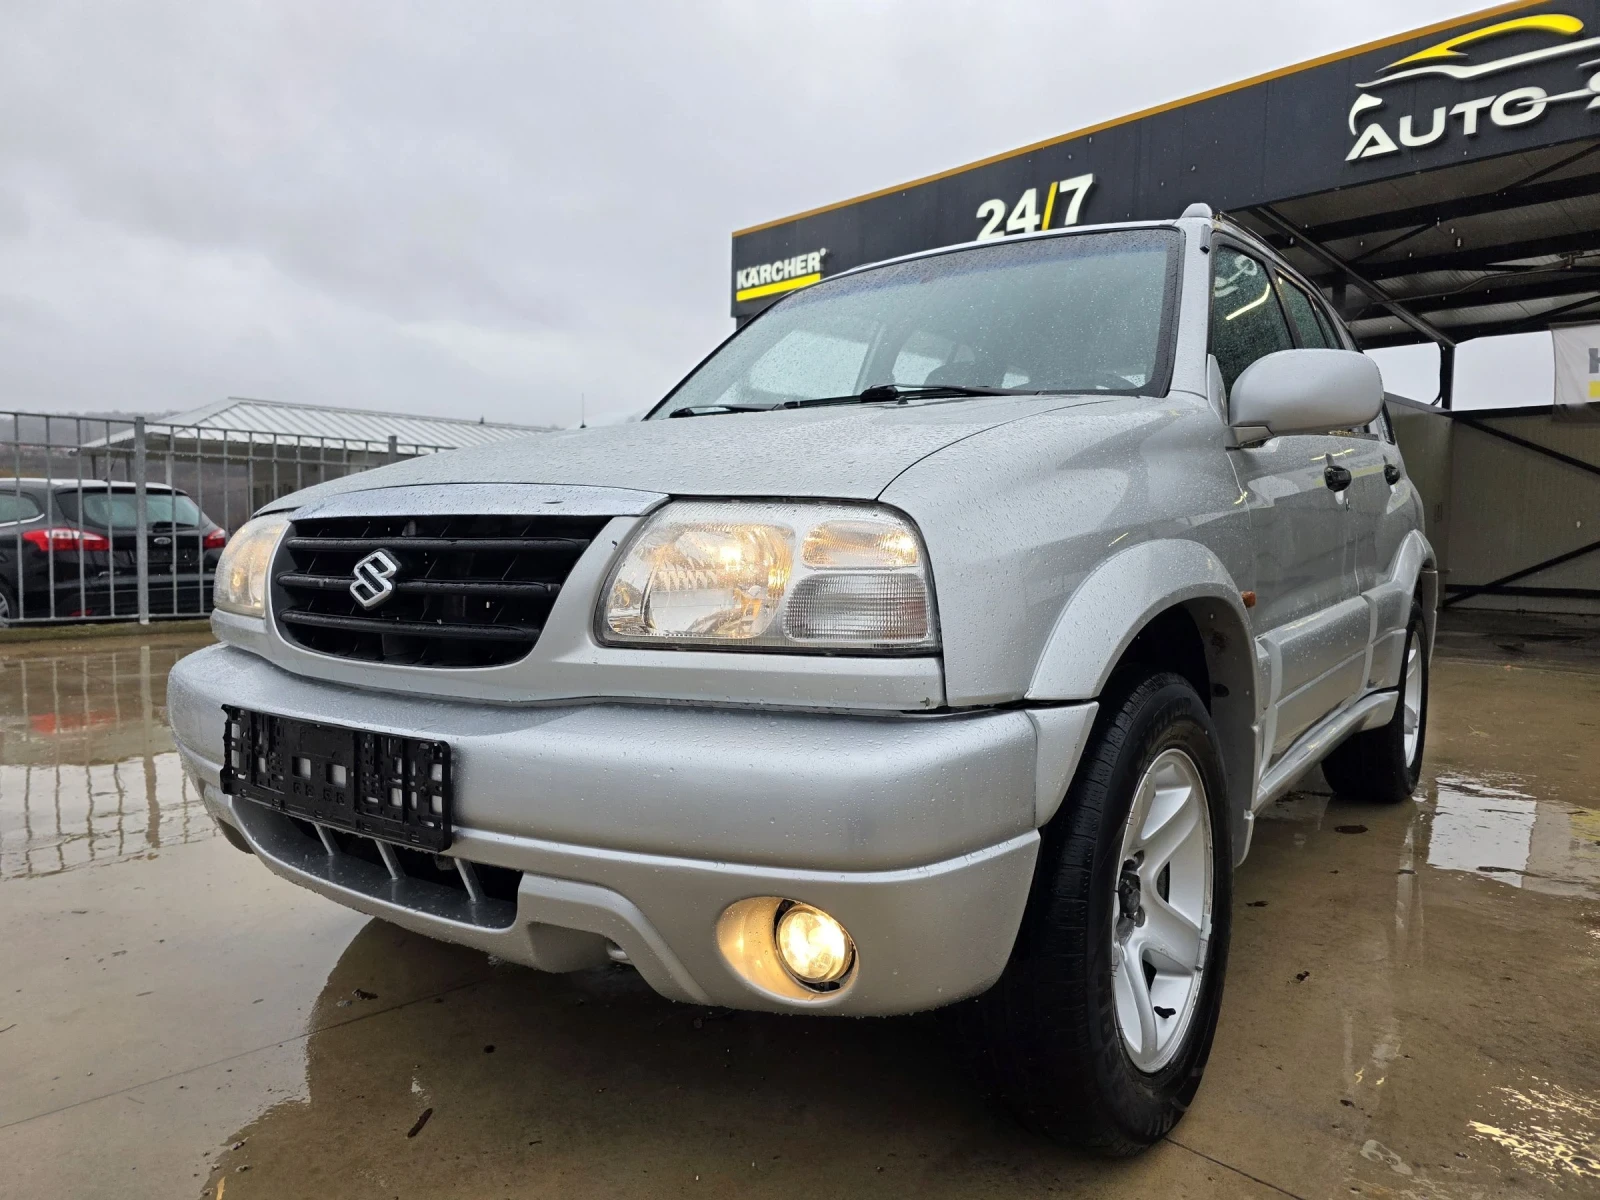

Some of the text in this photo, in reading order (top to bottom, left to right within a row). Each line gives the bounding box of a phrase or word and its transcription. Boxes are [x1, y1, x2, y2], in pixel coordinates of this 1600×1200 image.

[1345, 86, 1548, 161] AUTO
[976, 173, 1095, 241] 24/7
[736, 250, 822, 290] KÄRCHER
